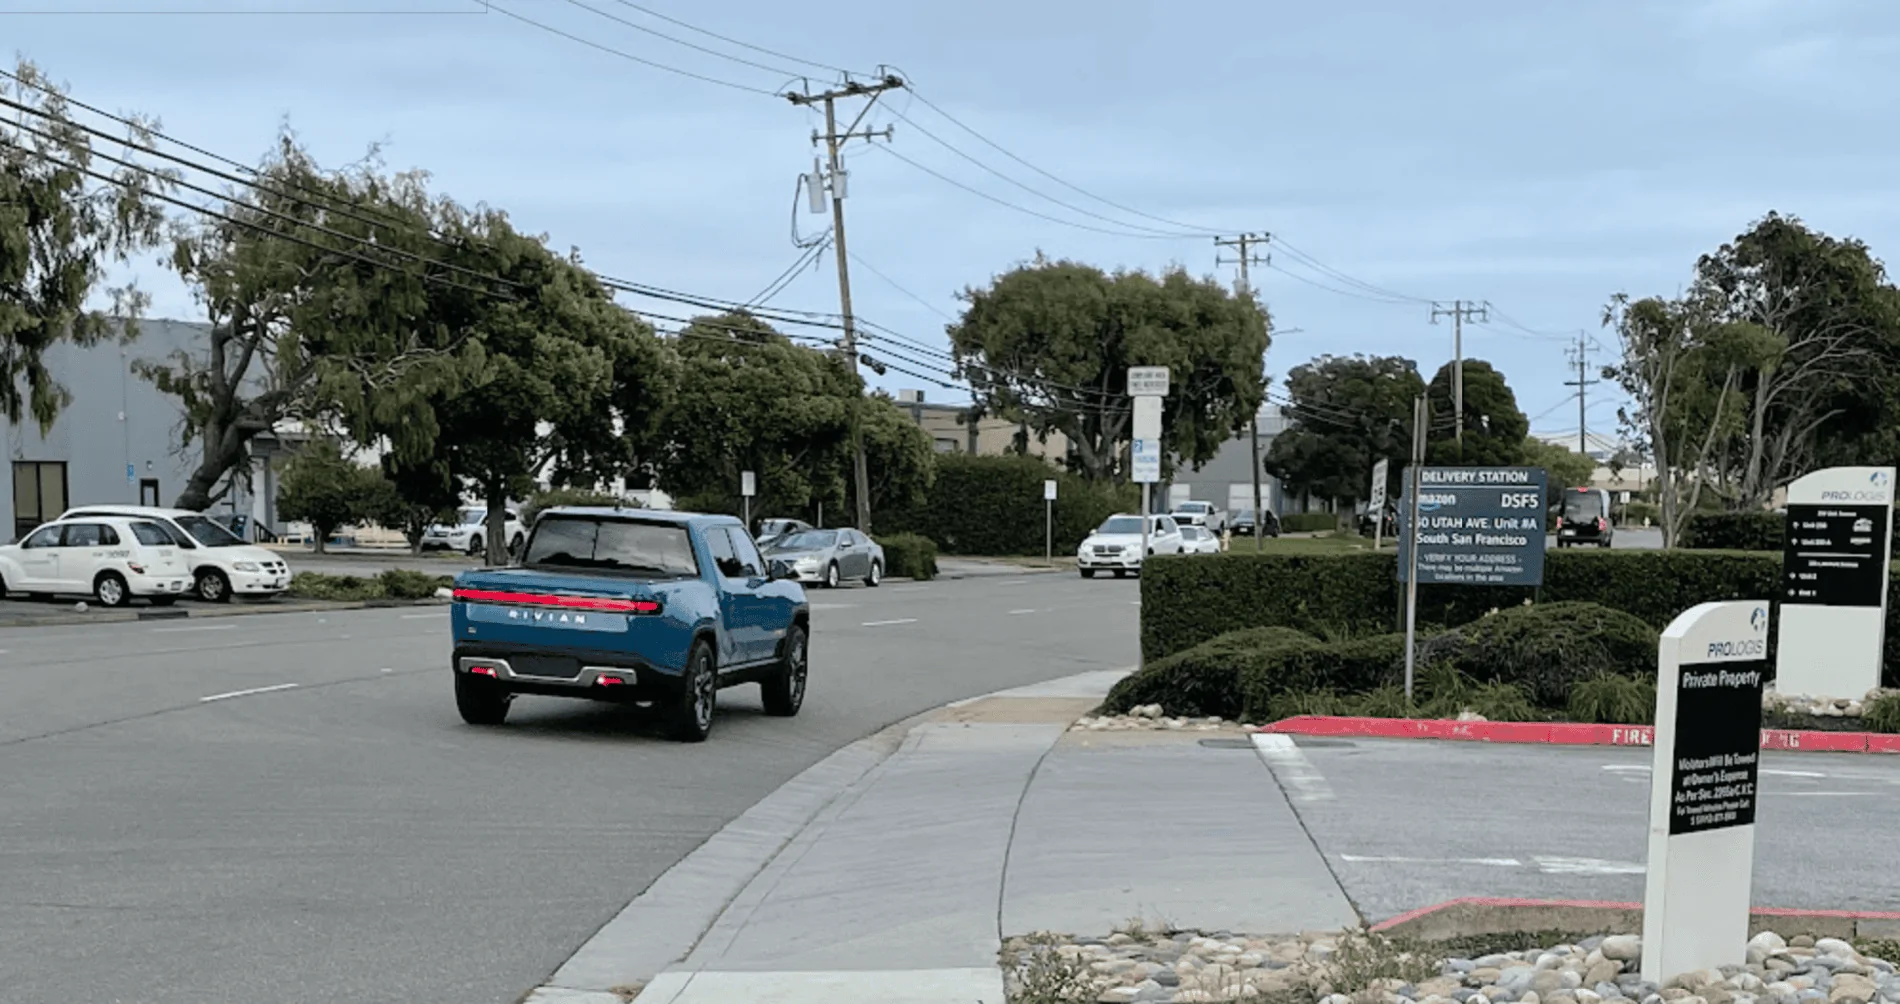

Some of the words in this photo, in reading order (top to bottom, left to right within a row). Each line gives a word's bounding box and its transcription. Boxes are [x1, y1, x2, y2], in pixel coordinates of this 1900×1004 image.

[1422, 471, 1474, 482] DELIVERY
[1479, 472, 1528, 483] STATION
[1501, 494, 1539, 508] DSF5
[1821, 490, 1886, 501] PROLOGIS
[1432, 516, 1463, 528] UTAH
[1494, 518, 1519, 529] Unit
[1416, 532, 1449, 544] South
[1452, 533, 1473, 545] San
[1475, 534, 1528, 546] Francisco
[509, 609, 586, 625] RIVIAN
[1707, 640, 1764, 658] PROLOGIS
[1682, 671, 1718, 689] Private
[1719, 669, 1762, 689] Property
[1613, 729, 1652, 745] FIRE
